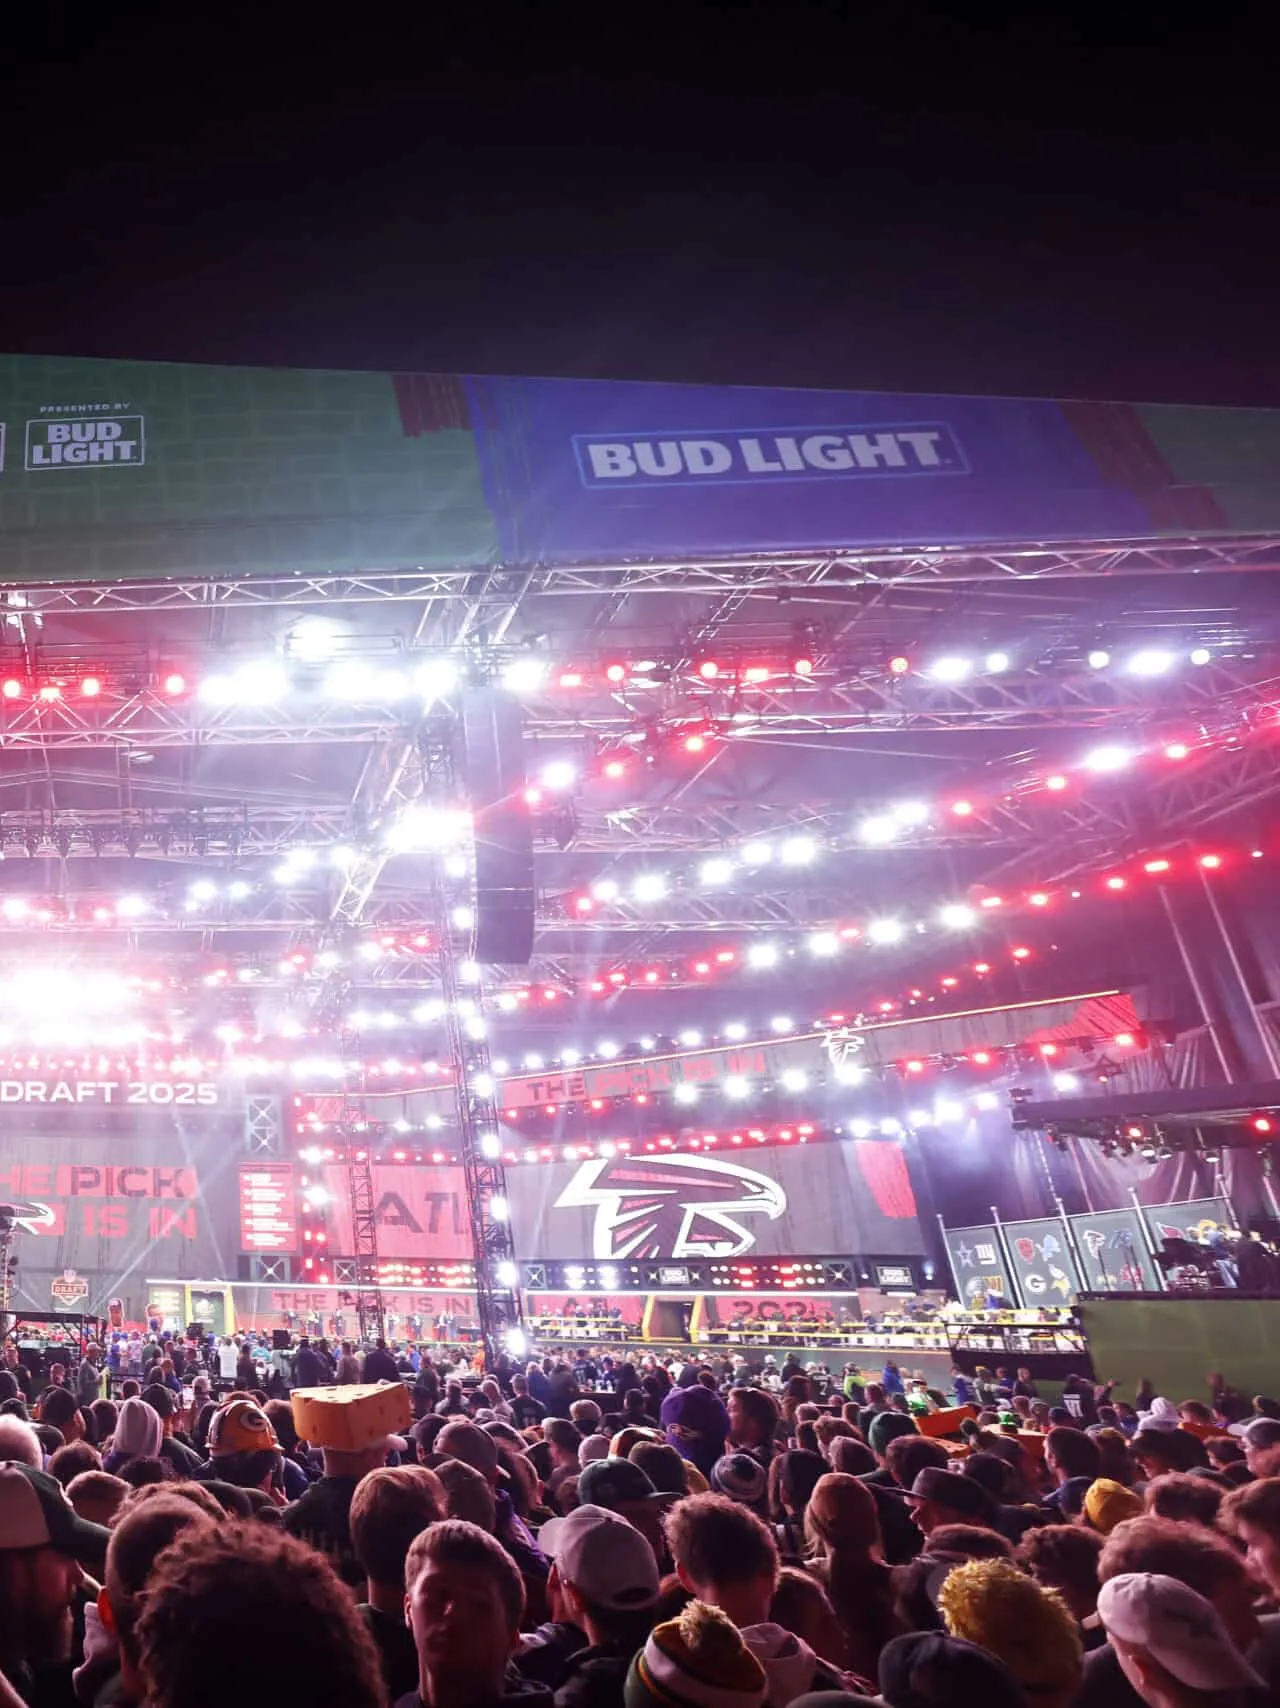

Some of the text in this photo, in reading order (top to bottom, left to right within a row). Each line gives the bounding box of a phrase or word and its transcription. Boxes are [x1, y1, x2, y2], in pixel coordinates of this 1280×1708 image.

[39, 401, 132, 414] PRESENTED BY
[47, 422, 122, 444] BUD
[32, 440, 135, 465] LIGHT
[587, 431, 941, 479] BUD LIGHT
[0, 1079, 120, 1103] DRAFT
[126, 1080, 220, 1105] 2025
[526, 1070, 585, 1101] THE
[70, 1165, 186, 1198] PICK
[83, 1204, 198, 1240] IS IN
[274, 1292, 327, 1310] THE
[410, 1296, 434, 1313] IS
[445, 1297, 471, 1315] IN
